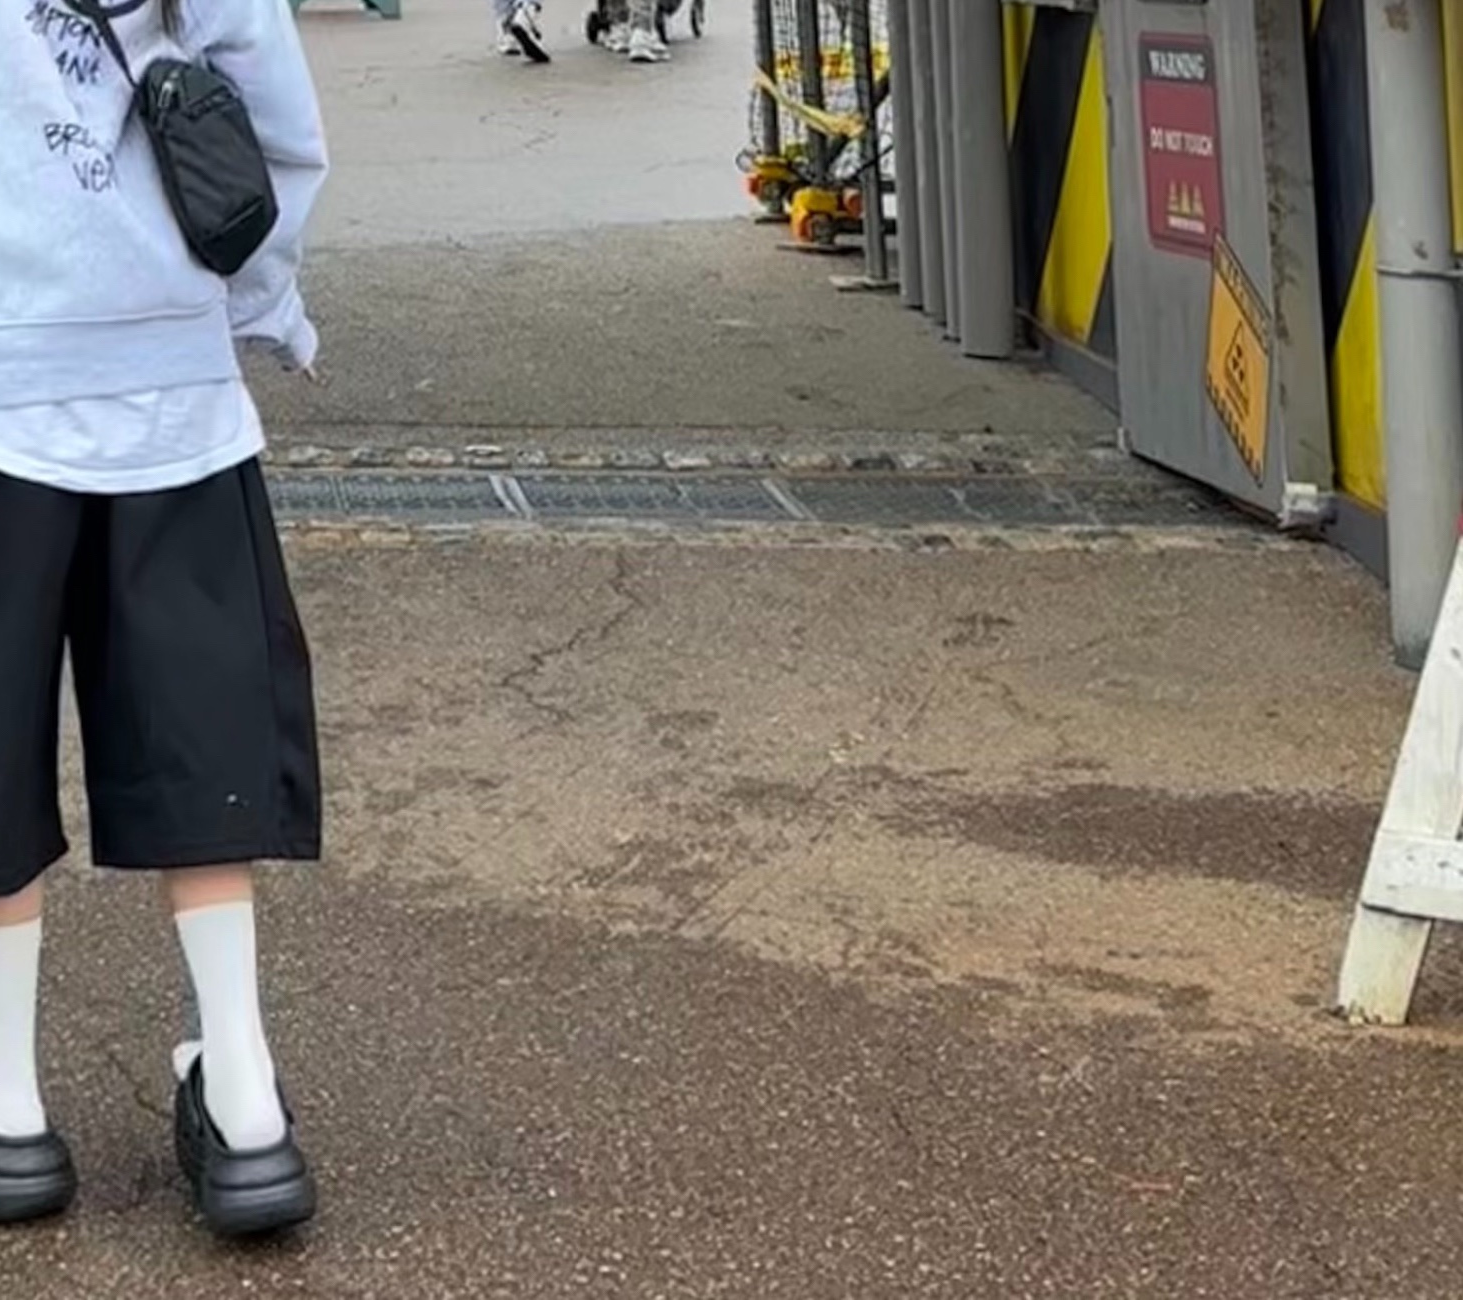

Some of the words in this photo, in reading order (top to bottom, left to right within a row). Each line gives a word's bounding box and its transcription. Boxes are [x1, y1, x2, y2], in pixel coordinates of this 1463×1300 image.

[1148, 50, 1207, 81] WARNING
[1149, 126, 1164, 151] DO
[1165, 129, 1183, 154] NOT
